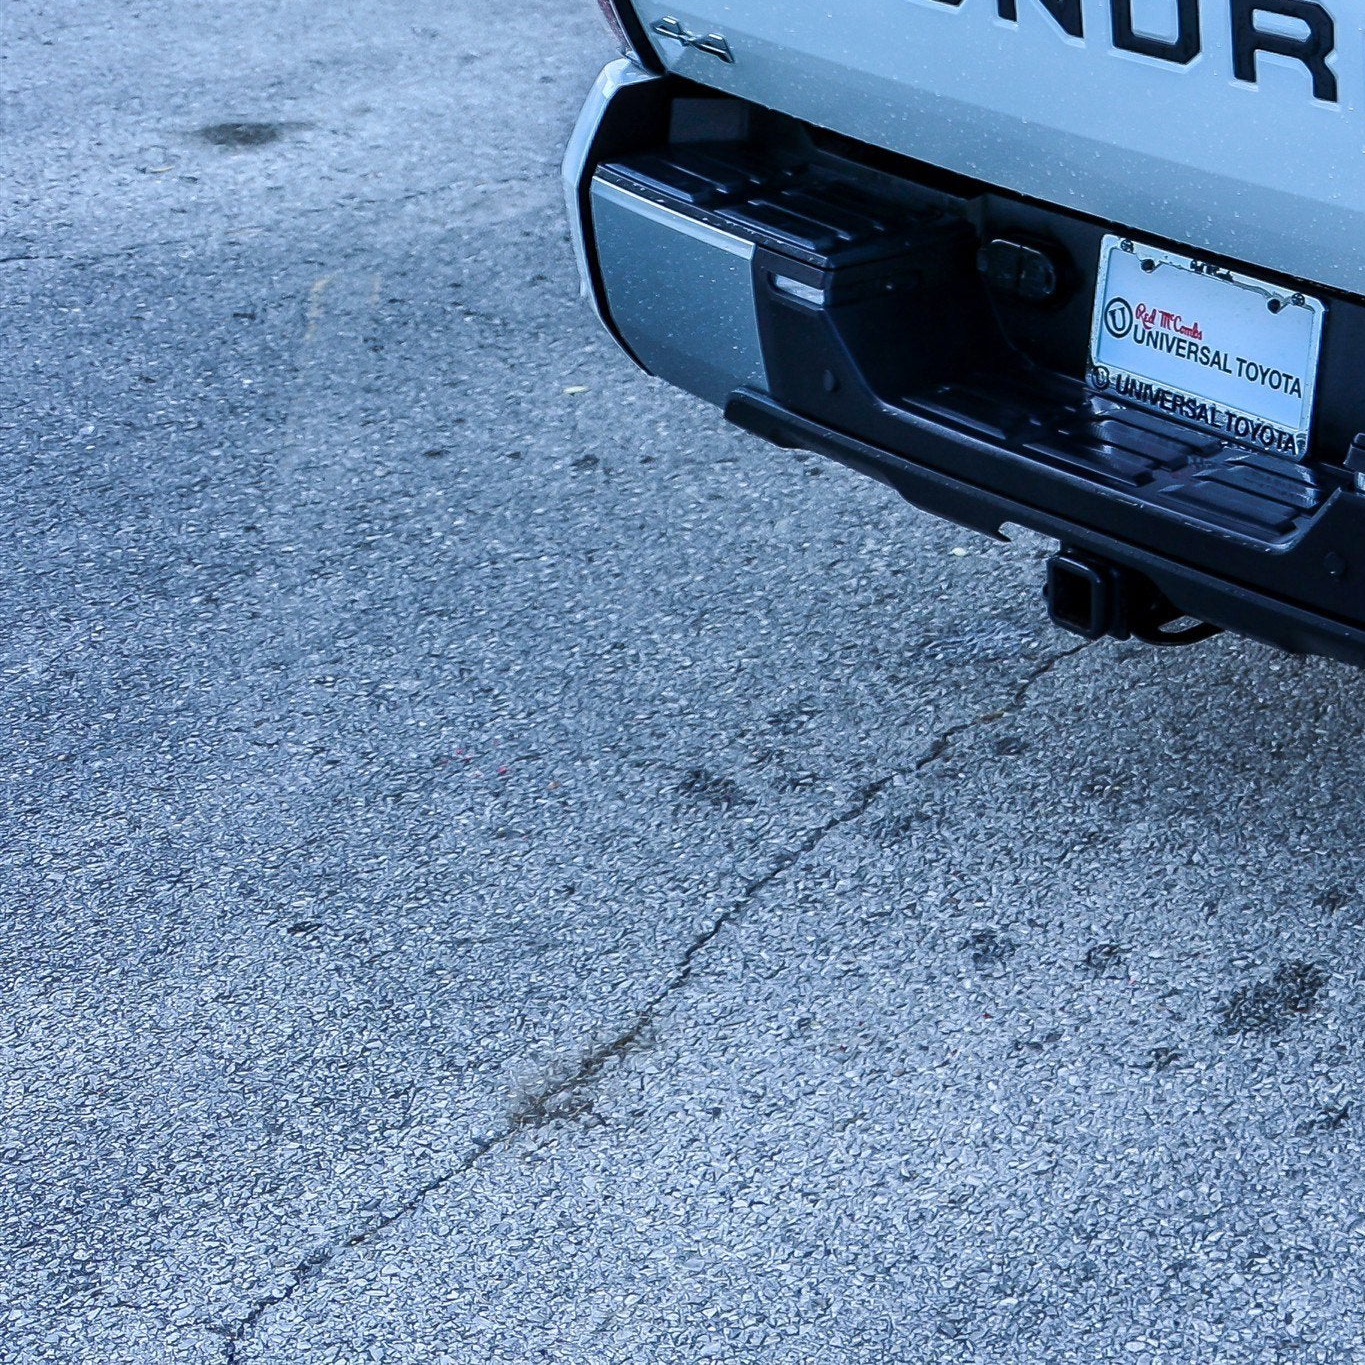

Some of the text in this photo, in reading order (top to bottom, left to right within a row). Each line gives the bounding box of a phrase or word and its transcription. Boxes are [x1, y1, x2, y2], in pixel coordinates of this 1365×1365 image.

[1135, 303, 1157, 330] Red
[1133, 324, 1302, 398] UNIVERSAL TOYOTA
[1114, 374, 1297, 455] UNIVERSAL TOYOTA
